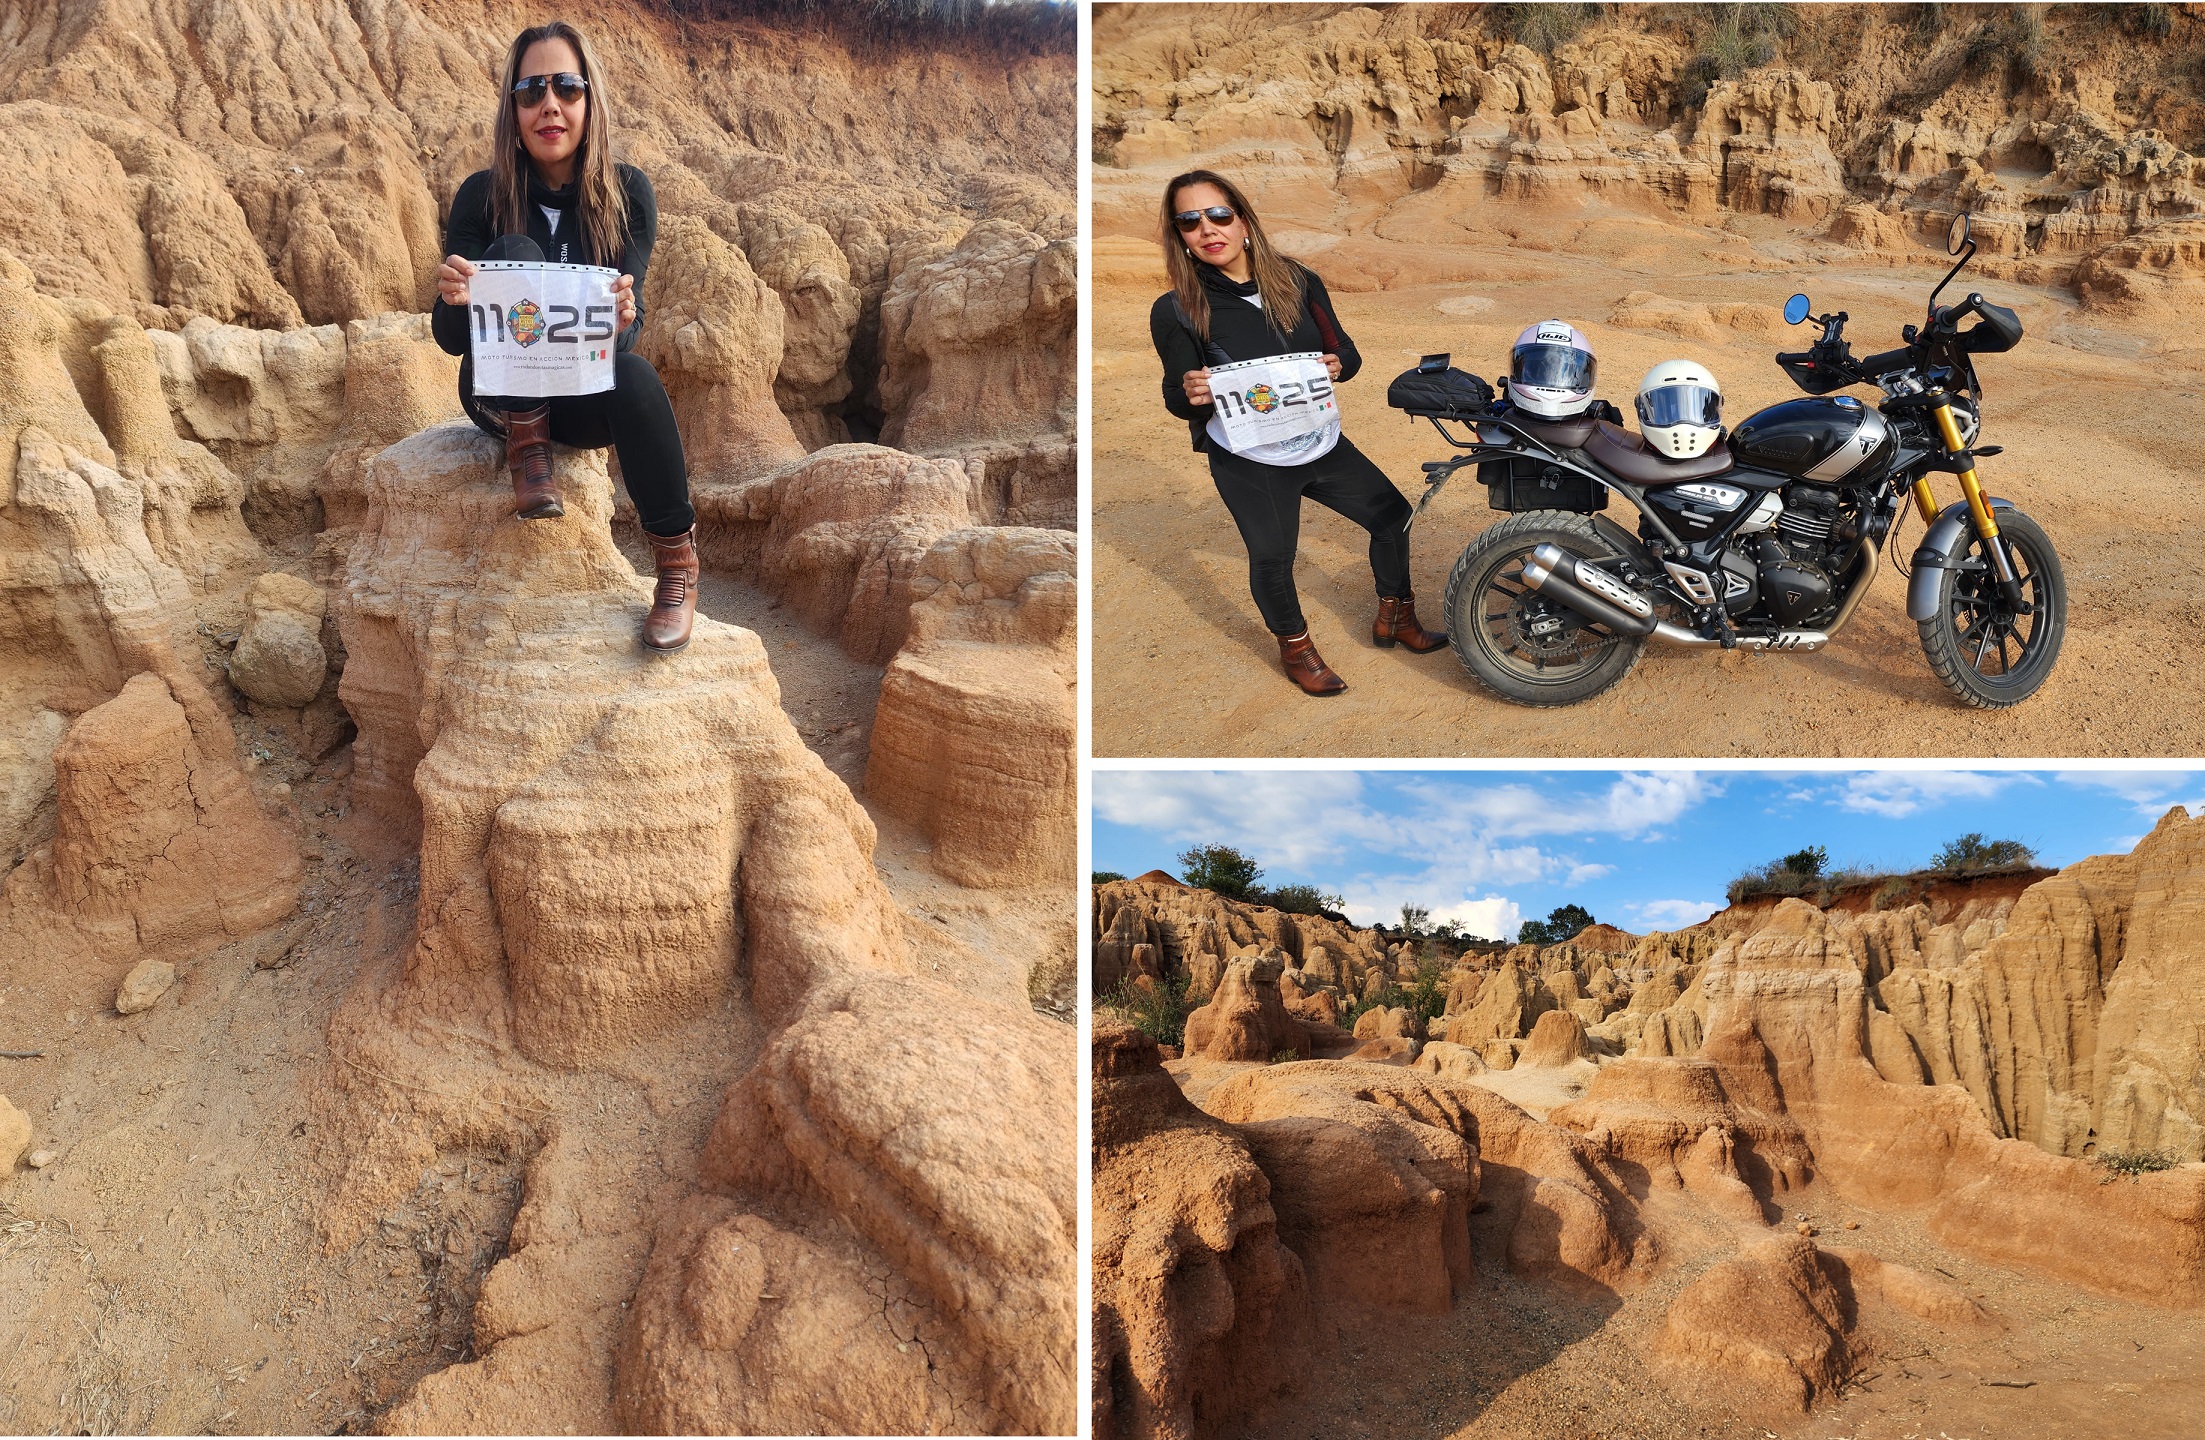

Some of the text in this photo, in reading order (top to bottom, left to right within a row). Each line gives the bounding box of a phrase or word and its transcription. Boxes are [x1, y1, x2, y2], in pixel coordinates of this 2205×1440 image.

[560, 242, 569, 263] WOS
[472, 303, 613, 344] 11 25
[1215, 376, 1333, 419] 11 25
